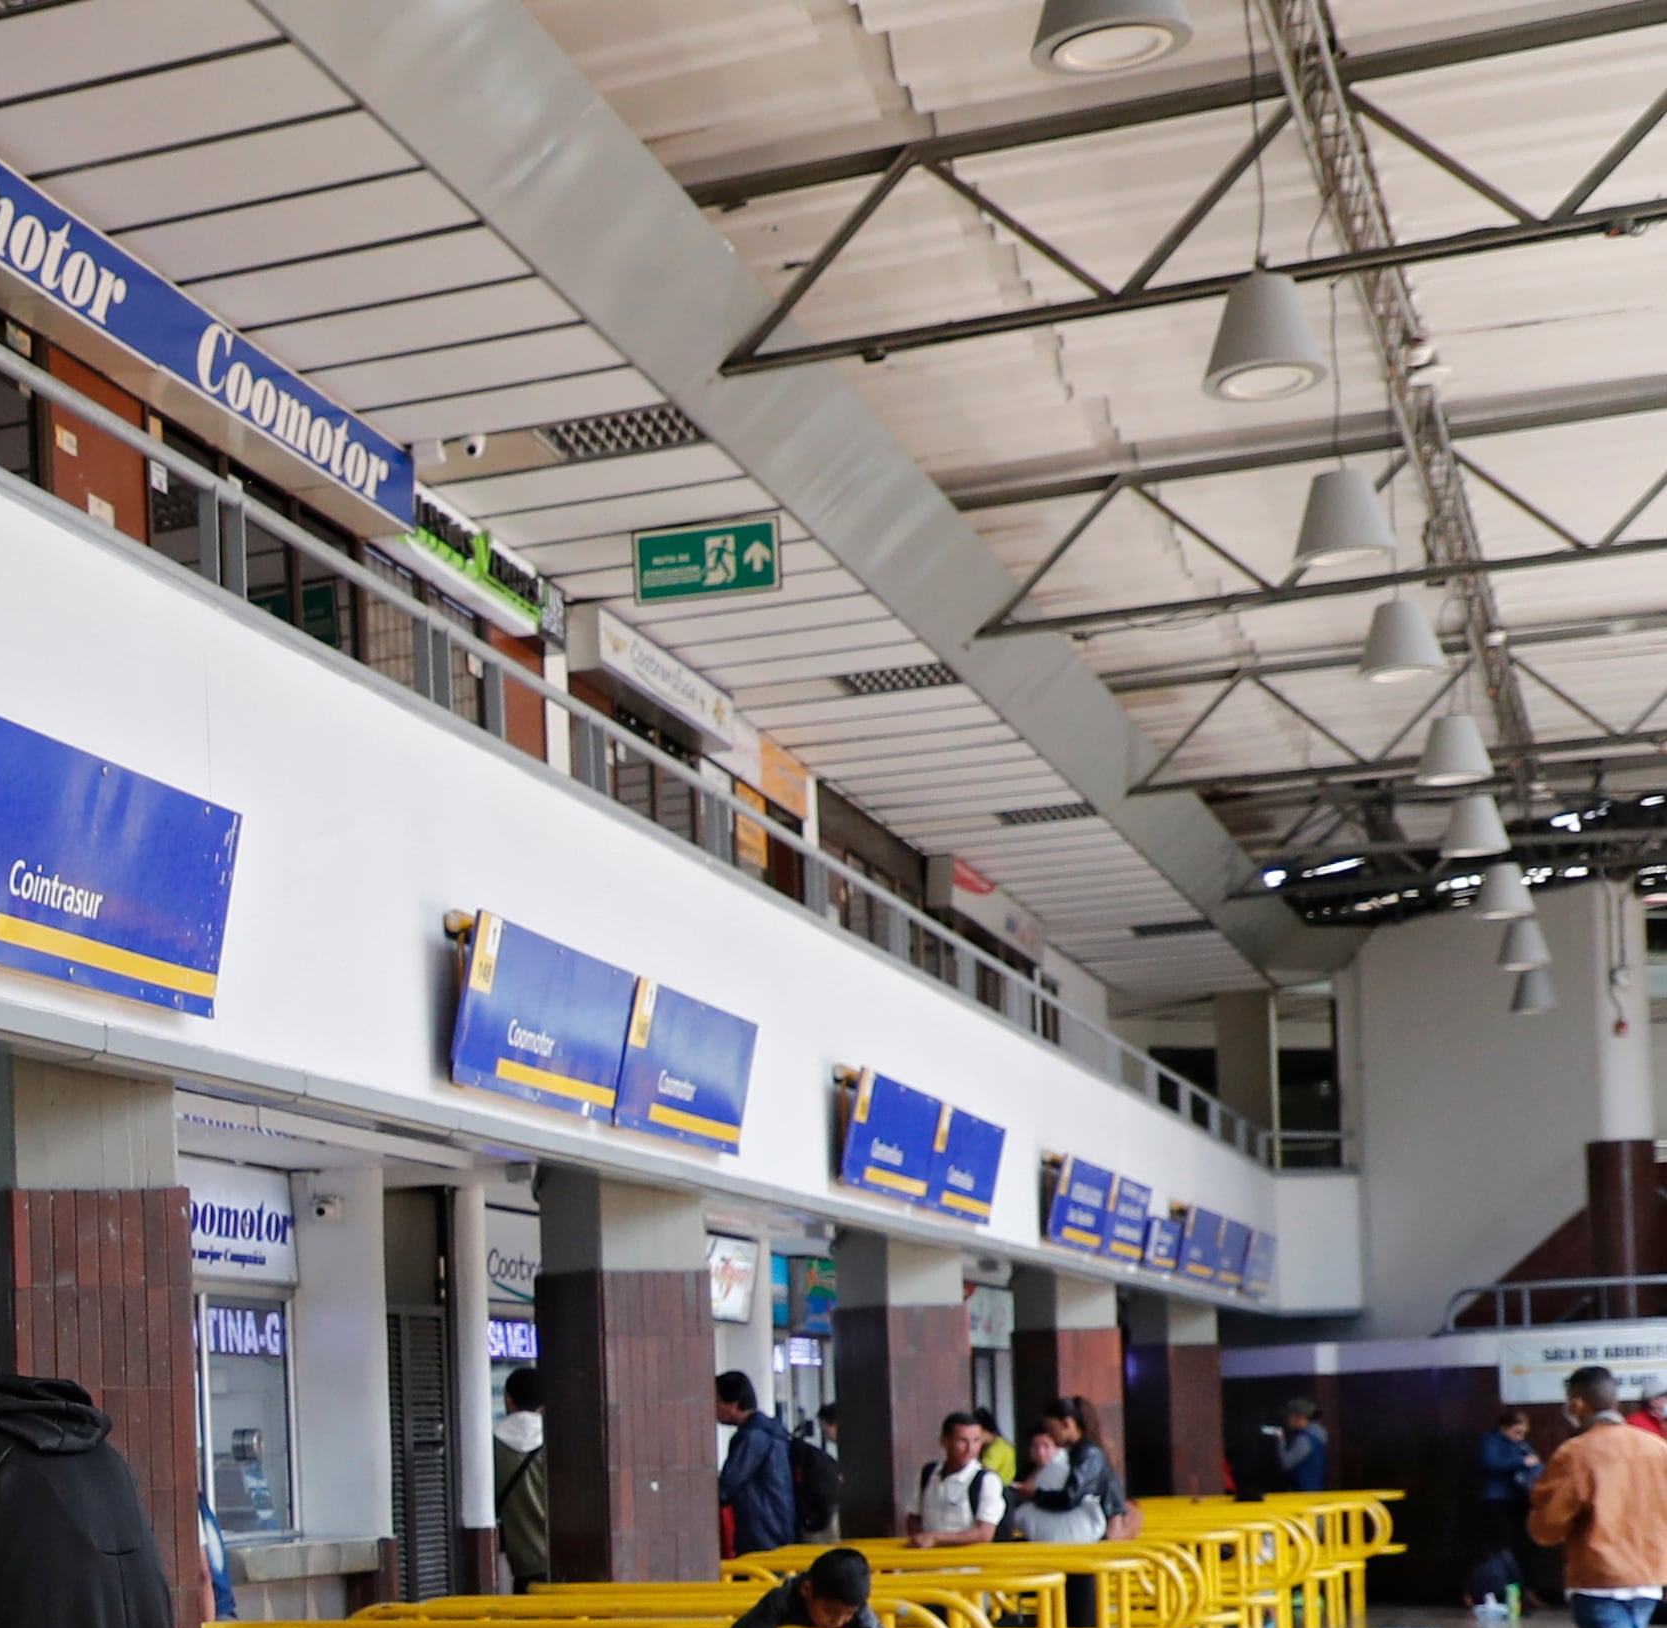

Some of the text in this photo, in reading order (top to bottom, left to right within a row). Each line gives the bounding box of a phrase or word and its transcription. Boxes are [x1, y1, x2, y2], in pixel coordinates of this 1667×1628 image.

[196, 321, 390, 502] Coomotor
[8, 858, 104, 920] Cointrasur
[506, 1018, 556, 1058] Coomotor
